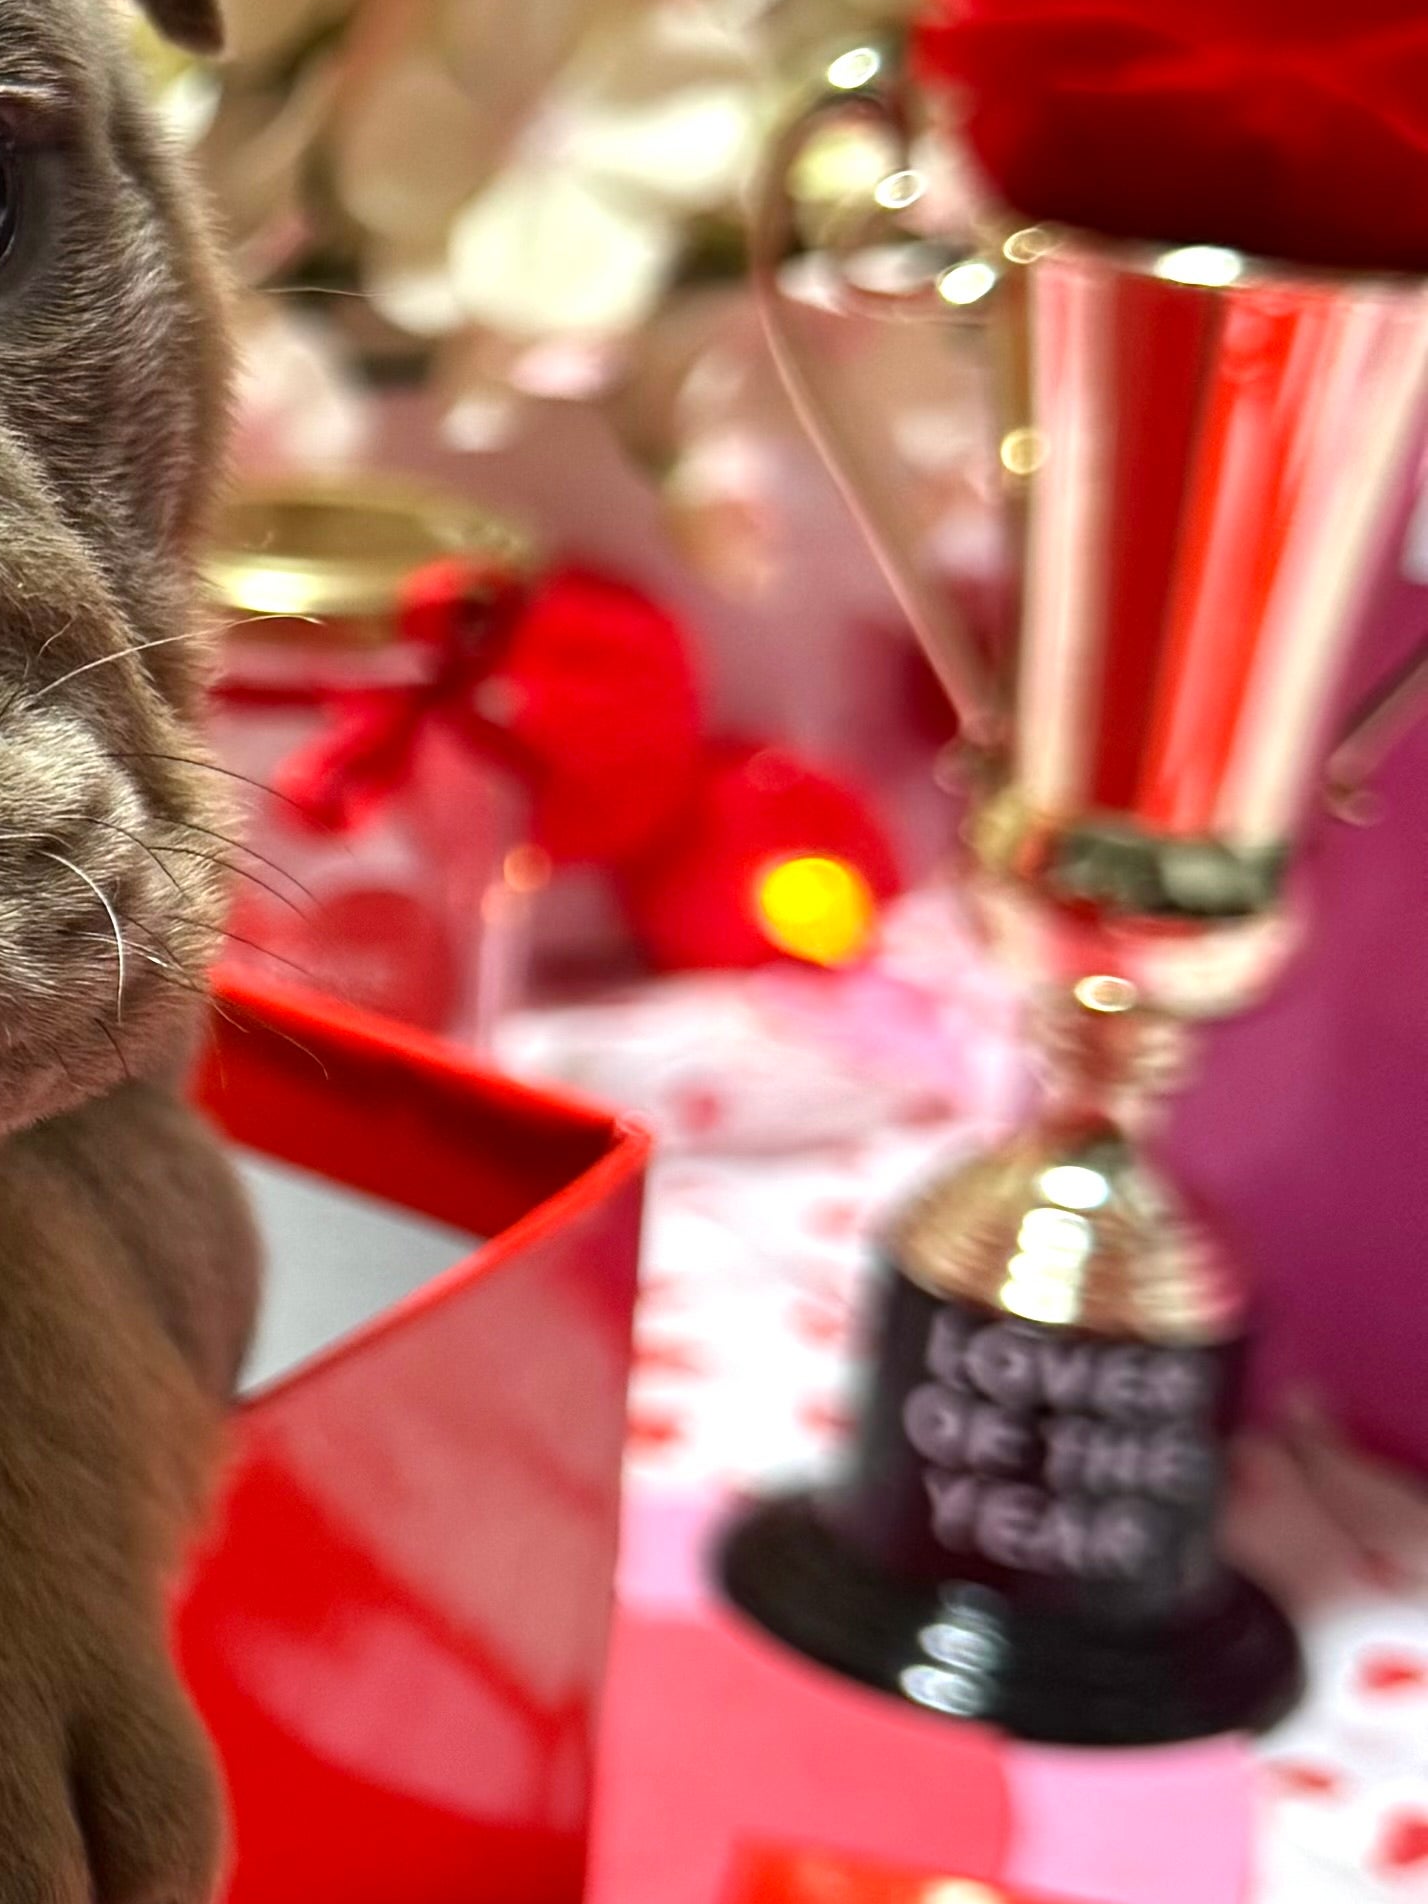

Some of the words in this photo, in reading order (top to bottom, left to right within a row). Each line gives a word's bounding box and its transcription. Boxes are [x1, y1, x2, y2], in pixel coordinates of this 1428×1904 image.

[927, 1308, 1202, 1418] LOVER
[904, 1383, 1030, 1468] OF
[1043, 1416, 1213, 1501] THE
[925, 1468, 1166, 1578] YEAR
